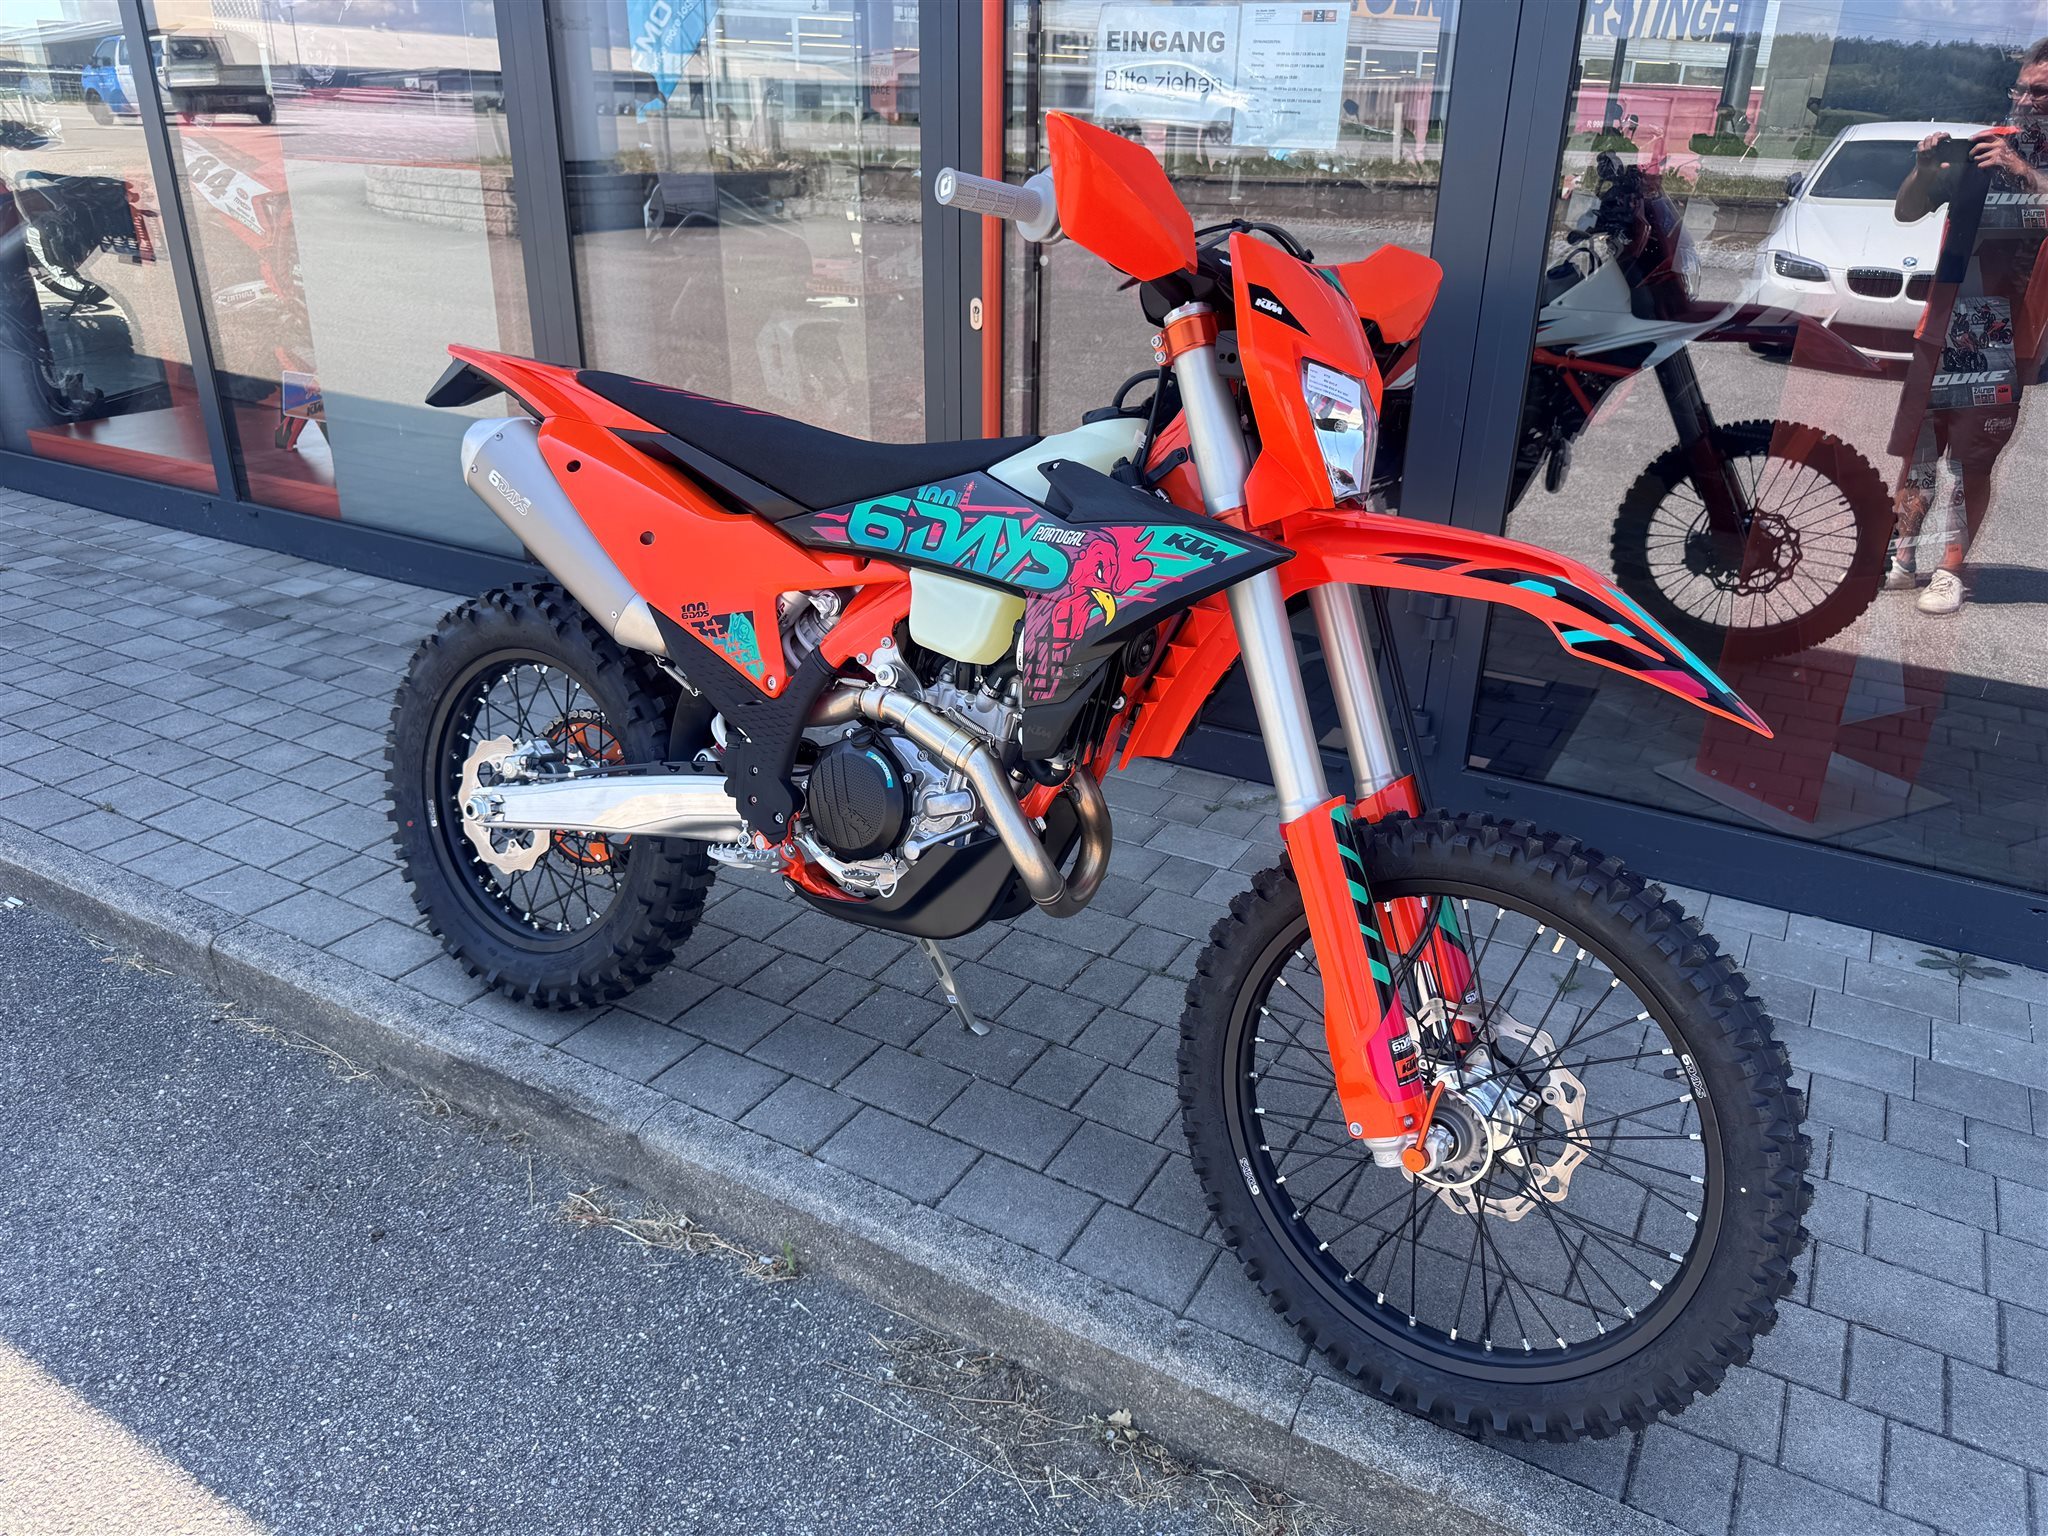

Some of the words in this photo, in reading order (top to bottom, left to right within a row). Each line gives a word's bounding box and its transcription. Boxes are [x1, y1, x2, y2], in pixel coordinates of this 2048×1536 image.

[1106, 30, 1225, 53] EINGANG
[1105, 69, 1148, 91] Bitte
[1155, 70, 1223, 93] ziehen
[1255, 297, 1283, 315] KTM
[1932, 369, 2010, 386] DUKE
[488, 469, 532, 516] 6DAYS
[846, 494, 1070, 590] 6DAYS
[1032, 524, 1086, 548] PORTUGAL
[1163, 532, 1230, 565] KTM
[681, 610, 710, 620] 6DAYS
[1681, 1053, 1707, 1100] 6DAYS
